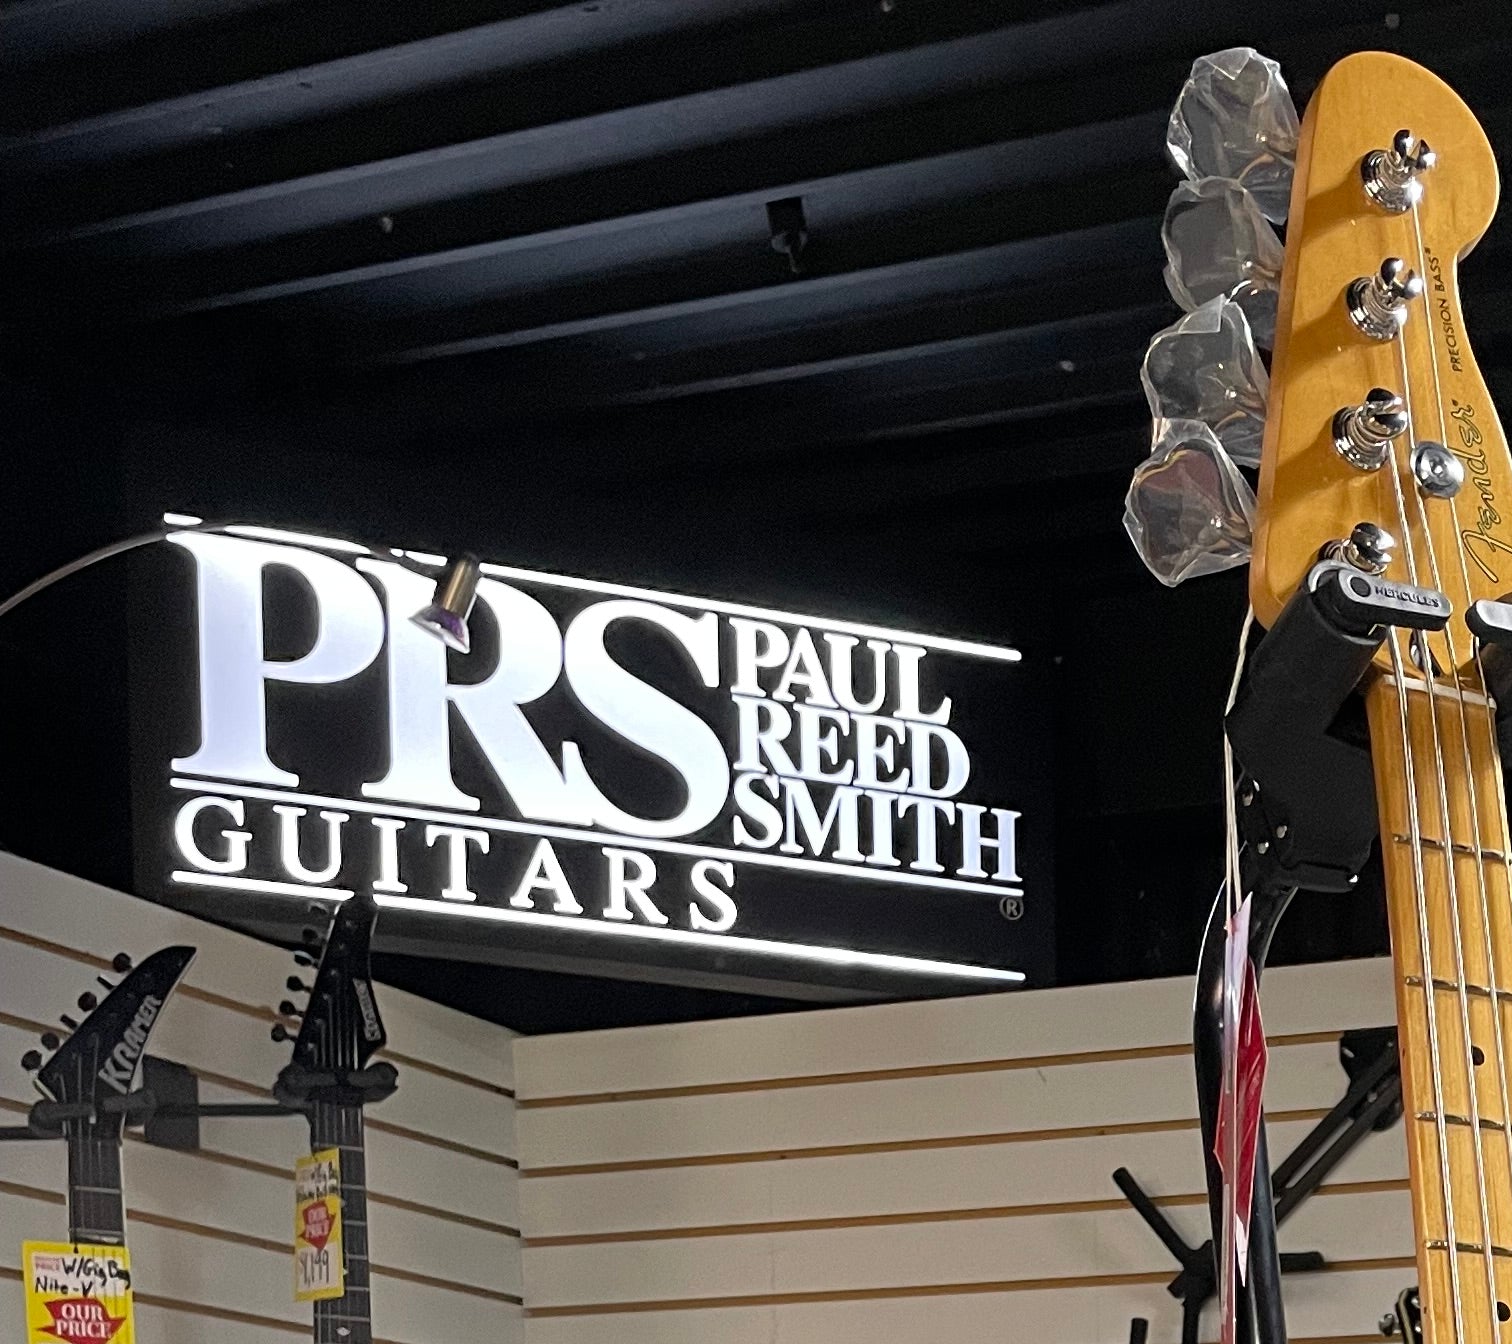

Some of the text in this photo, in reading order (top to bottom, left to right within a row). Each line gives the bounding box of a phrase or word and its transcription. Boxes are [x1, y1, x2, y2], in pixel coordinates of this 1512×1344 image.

[1437, 298, 1463, 373] PRECISION
[166, 530, 731, 838] PRS
[728, 616, 953, 726] PAUL
[731, 694, 971, 799] REED
[173, 797, 739, 933] GUITARS
[733, 771, 1024, 882] SMITH
[98, 994, 162, 1095] KRAMER
[55, 1319, 113, 1338] PRICE
[61, 1302, 104, 1321] OUR
